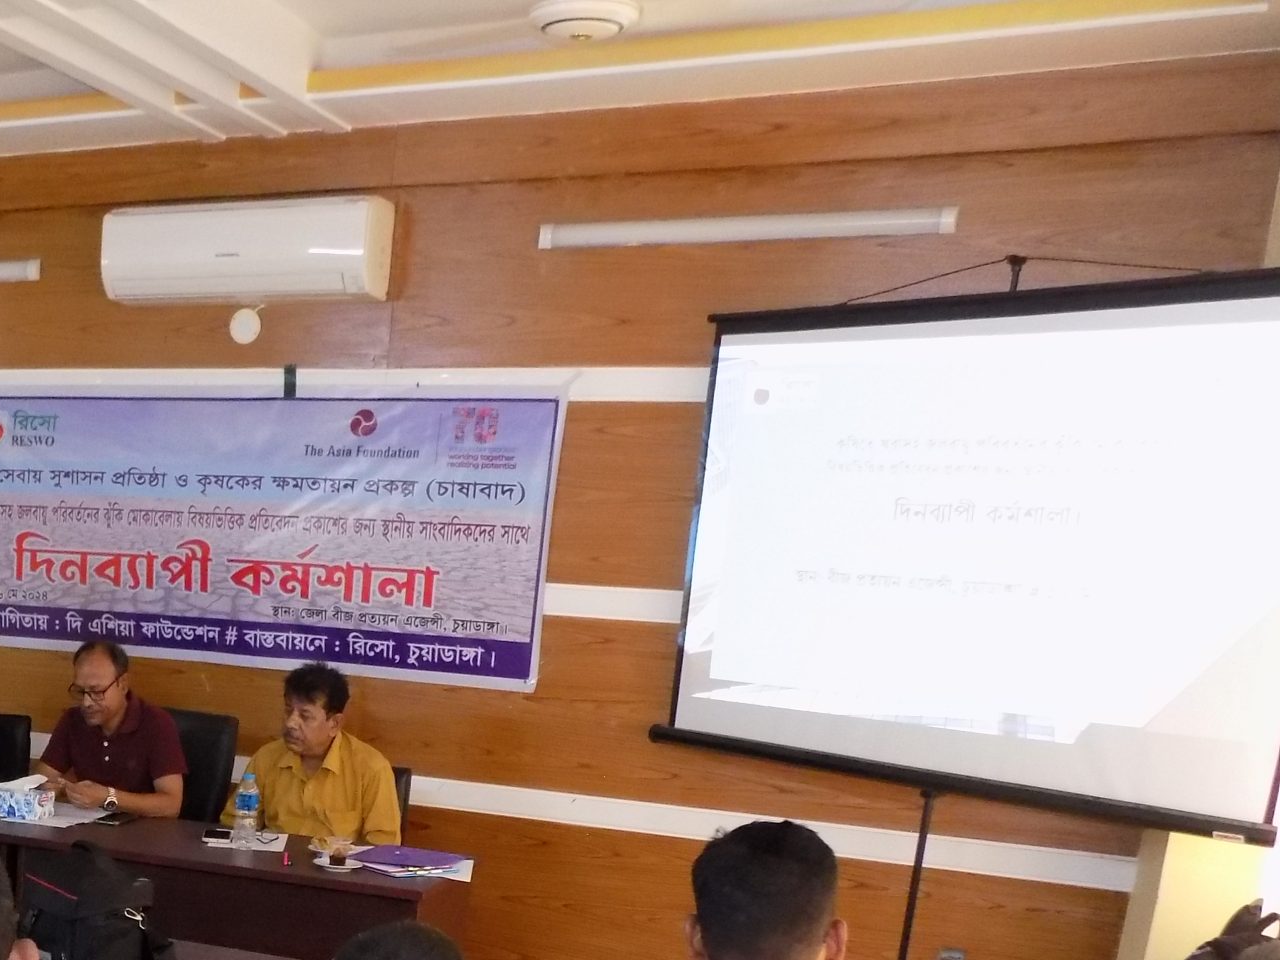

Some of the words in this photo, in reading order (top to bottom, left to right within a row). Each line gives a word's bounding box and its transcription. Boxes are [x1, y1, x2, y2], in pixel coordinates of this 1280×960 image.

[12, 410, 58, 432] রিসো
[451, 406, 499, 444] 70
[11, 435, 55, 447] RESWO
[304, 444, 324, 457] The
[327, 445, 352, 458] Asia
[356, 446, 420, 459] Foundation
[448, 453, 479, 462] working
[480, 453, 516, 463] together
[480, 461, 517, 470] potential
[49, 468, 107, 489] সুশাসন
[111, 466, 168, 488] প্রতিষ্ঠা
[174, 473, 189, 488] ও
[195, 474, 264, 495] কৃষকের
[270, 475, 358, 495] ক্ষমতায়ন
[363, 478, 418, 498] প্রকল্প
[425, 478, 526, 506] (চাষাবাদ)
[893, 496, 977, 524] দিনব্যাপী
[52, 499, 100, 524] পরিবর্তনের
[127, 508, 184, 528] মোকাবেলায়
[187, 504, 246, 530] বিষয়ভিত্তিক
[247, 507, 299, 533] প্রতিবেদন
[302, 514, 349, 536] প্রকাশের
[352, 518, 377, 538] জন্য
[381, 512, 415, 543] স্থানীয়
[419, 516, 497, 543] সাংবাদিকদের
[500, 523, 531, 546] সাথে
[12, 530, 213, 594] দিনব্যাপী
[226, 543, 441, 609] কর্মশালা
[7, 588, 19, 599] মে
[299, 608, 327, 622] জেলা
[332, 606, 355, 624] বীজ
[358, 612, 399, 628] প্রত্যয়ন
[65, 612, 83, 634] দি
[88, 612, 136, 639] এশিয়া
[140, 619, 221, 646] ফাউন্ডেশন
[243, 628, 328, 652] বাস্তবায়নে
[346, 633, 401, 663] রিসো,
